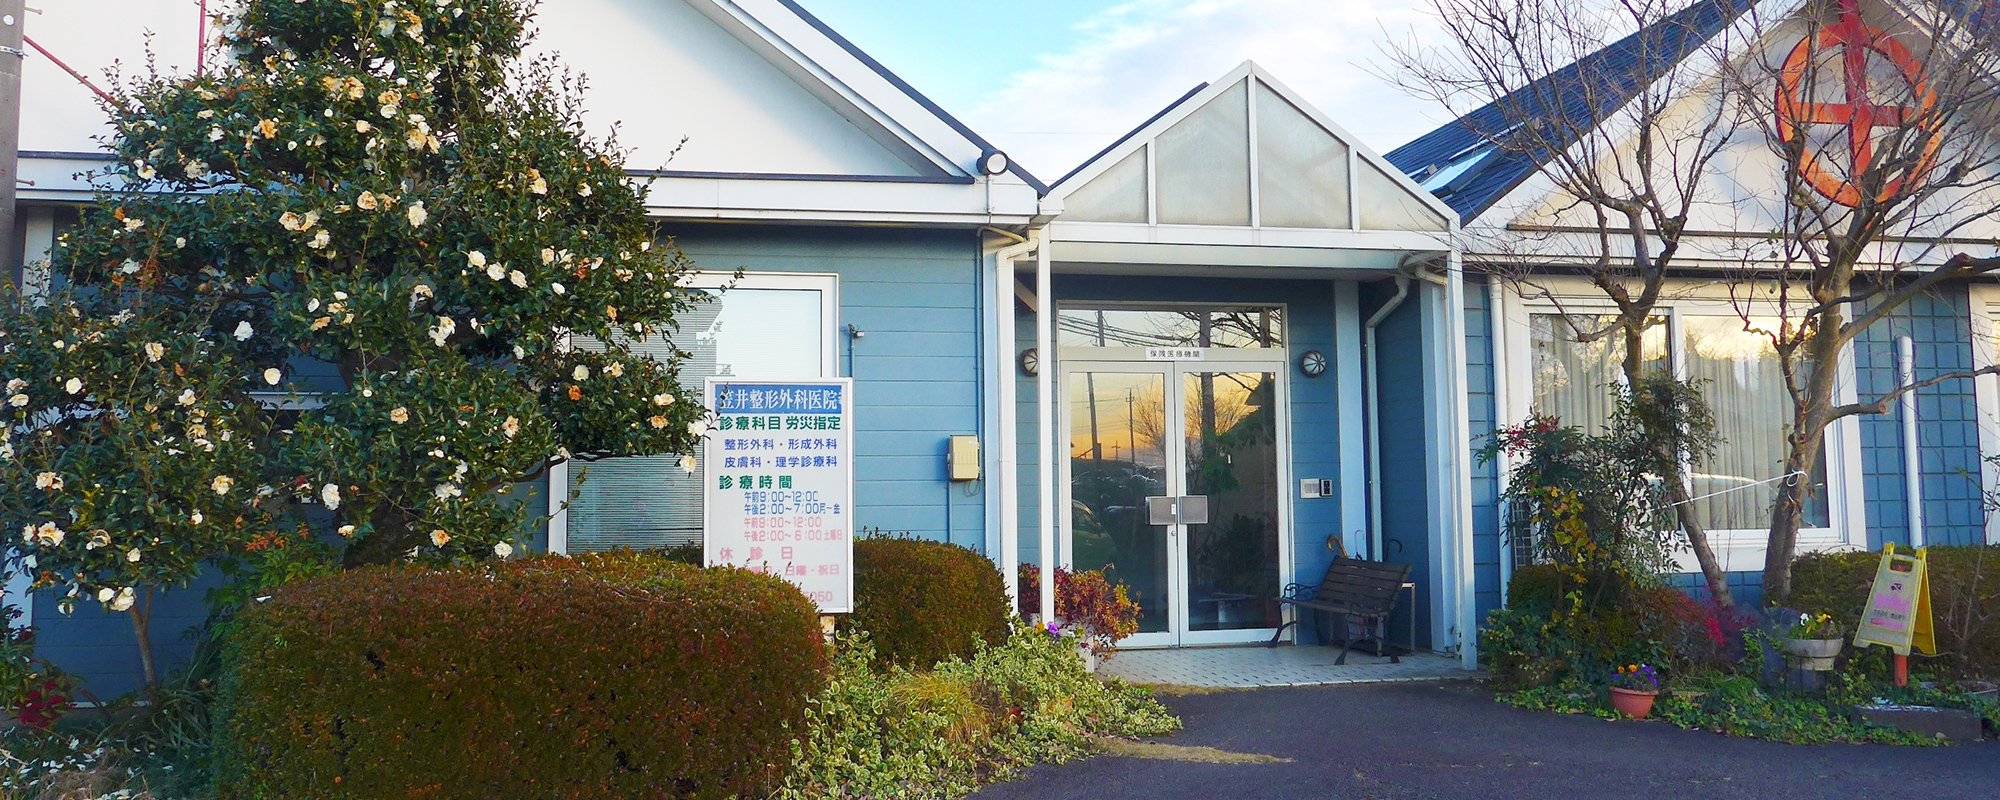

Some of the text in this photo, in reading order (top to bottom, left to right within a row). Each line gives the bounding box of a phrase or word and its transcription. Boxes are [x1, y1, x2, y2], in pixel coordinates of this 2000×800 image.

[719, 416, 841, 431] 診療科目 労災指定
[724, 438, 838, 451] 整形外科・形成外科
[724, 455, 838, 469] 皮膚科・理学診療科
[719, 475, 793, 490] 診療時間
